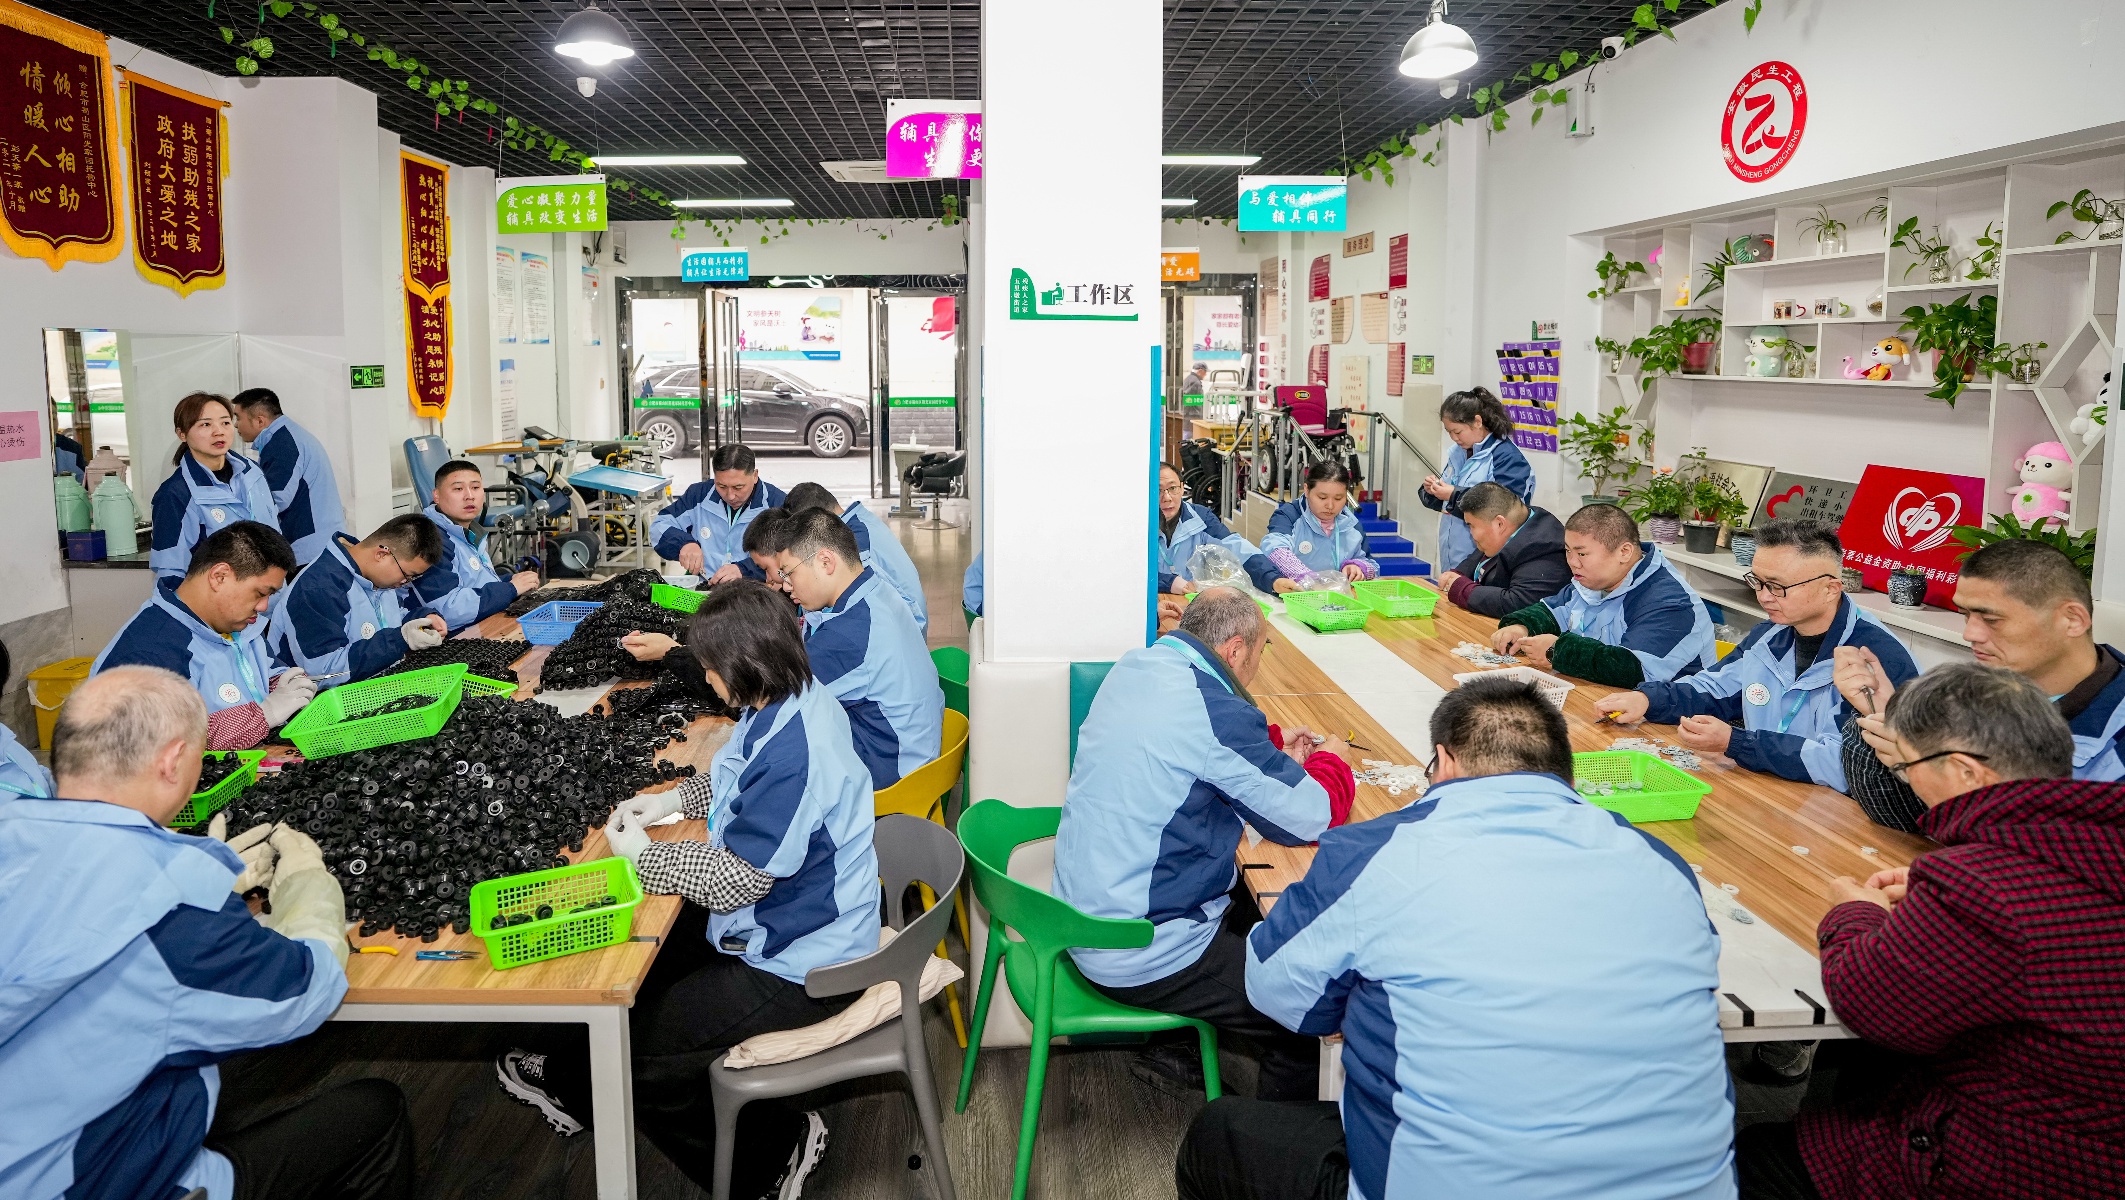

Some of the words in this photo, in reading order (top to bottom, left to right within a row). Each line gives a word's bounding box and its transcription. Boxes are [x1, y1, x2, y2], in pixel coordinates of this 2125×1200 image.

[1727, 64, 1803, 117] 安徽民生工程
[20, 61, 51, 205] 情暖人心
[53, 71, 81, 214] 倾心相助
[1733, 164, 1763, 179] MINSHENG
[1764, 129, 1801, 175] GONGCHENG
[156, 114, 179, 251] 政府大爱之地
[181, 121, 202, 253] 扶弱助残之家
[506, 190, 597, 208] 爱心凝聚力量
[506, 209, 598, 227] 辅具改变生活
[1272, 209, 1336, 225] 辅具同行
[686, 256, 744, 267] 生活因辅具而精彩
[686, 266, 744, 277] 辅具让生活无障碍
[1160, 267, 1195, 277] 活无碍
[1066, 284, 1134, 305] 工作区
[1501, 364, 1508, 372] 01
[1510, 363, 1516, 371] 02
[1528, 361, 1535, 370] 04
[1538, 361, 1544, 370] 05
[1501, 387, 1508, 395] 07
[1520, 387, 1526, 395] 09
[1538, 387, 1544, 396] 11
[1547, 388, 1553, 396] 12
[1519, 411, 1526, 419] 15
[1527, 412, 1533, 420] 16
[1535, 414, 1541, 422] 17
[1517, 435, 1524, 444] 21
[1526, 436, 1532, 444] 22
[1534, 438, 1542, 446] 23
[1808, 485, 1848, 500] 环卫工
[1804, 496, 1842, 511] 快递小
